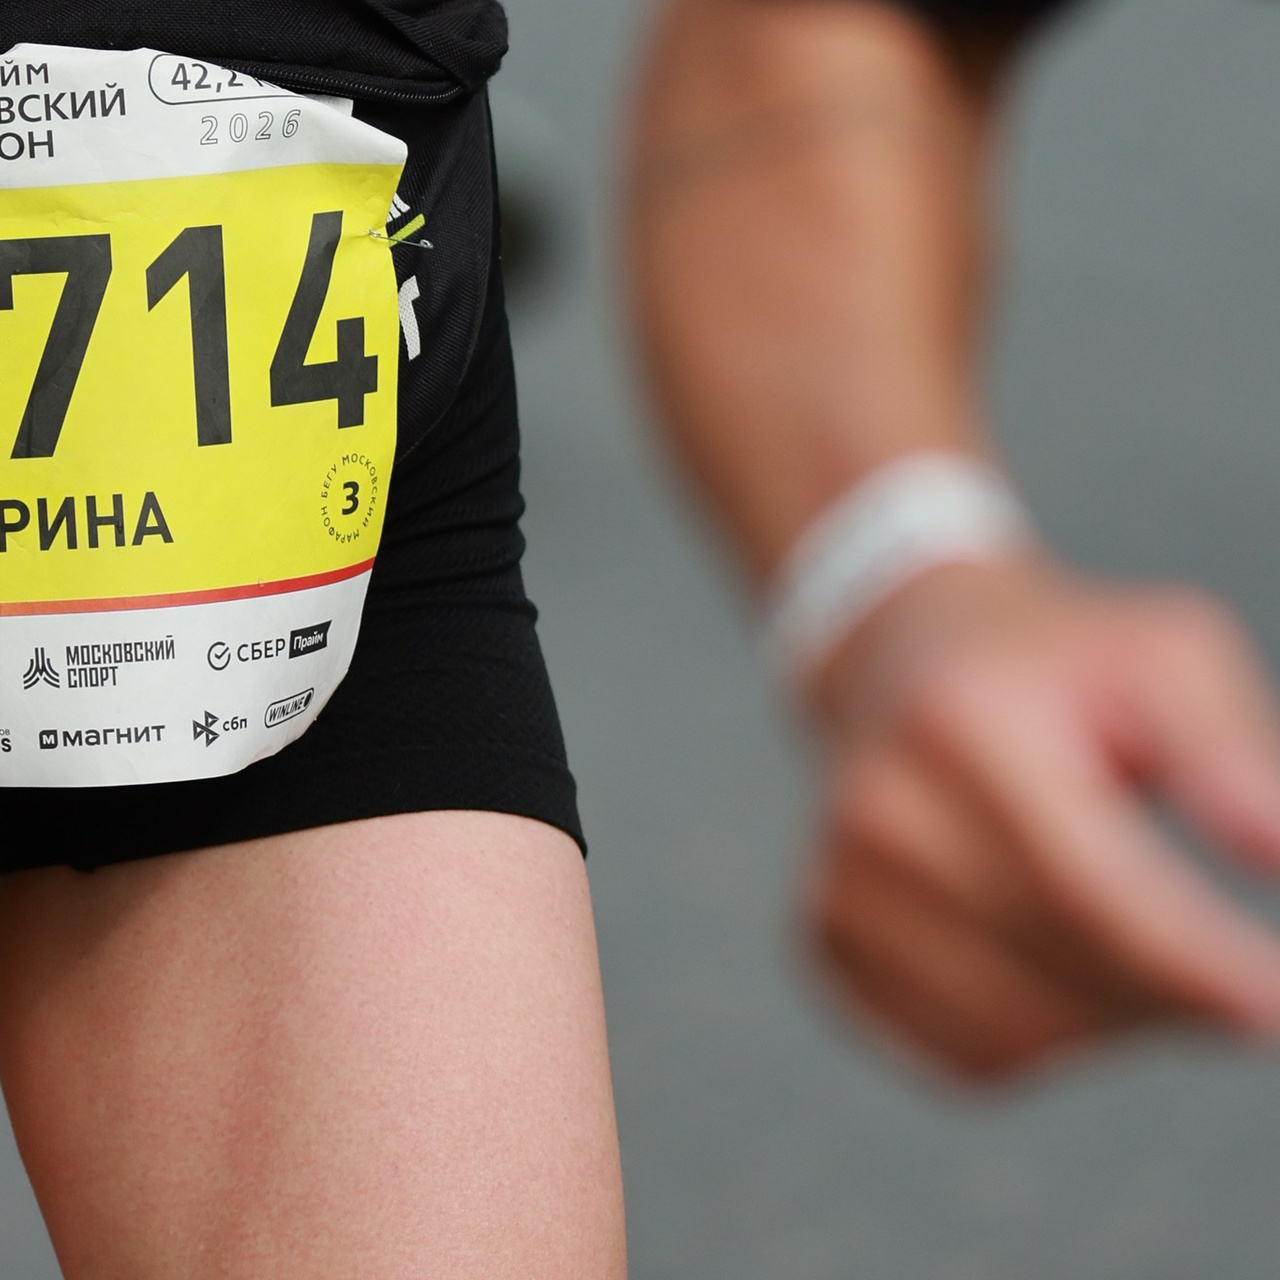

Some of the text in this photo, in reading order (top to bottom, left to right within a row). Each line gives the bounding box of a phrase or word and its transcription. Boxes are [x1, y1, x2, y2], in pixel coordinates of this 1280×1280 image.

[199, 108, 302, 146] 2026
[341, 480, 360, 516] 3
[65, 634, 176, 667] МОСКОВСКИЙ
[236, 630, 324, 663] СБЕР Прайм
[67, 665, 119, 689] СПОРТ
[222, 715, 249, 732] сбп
[268, 696, 305, 723] WINLINE
